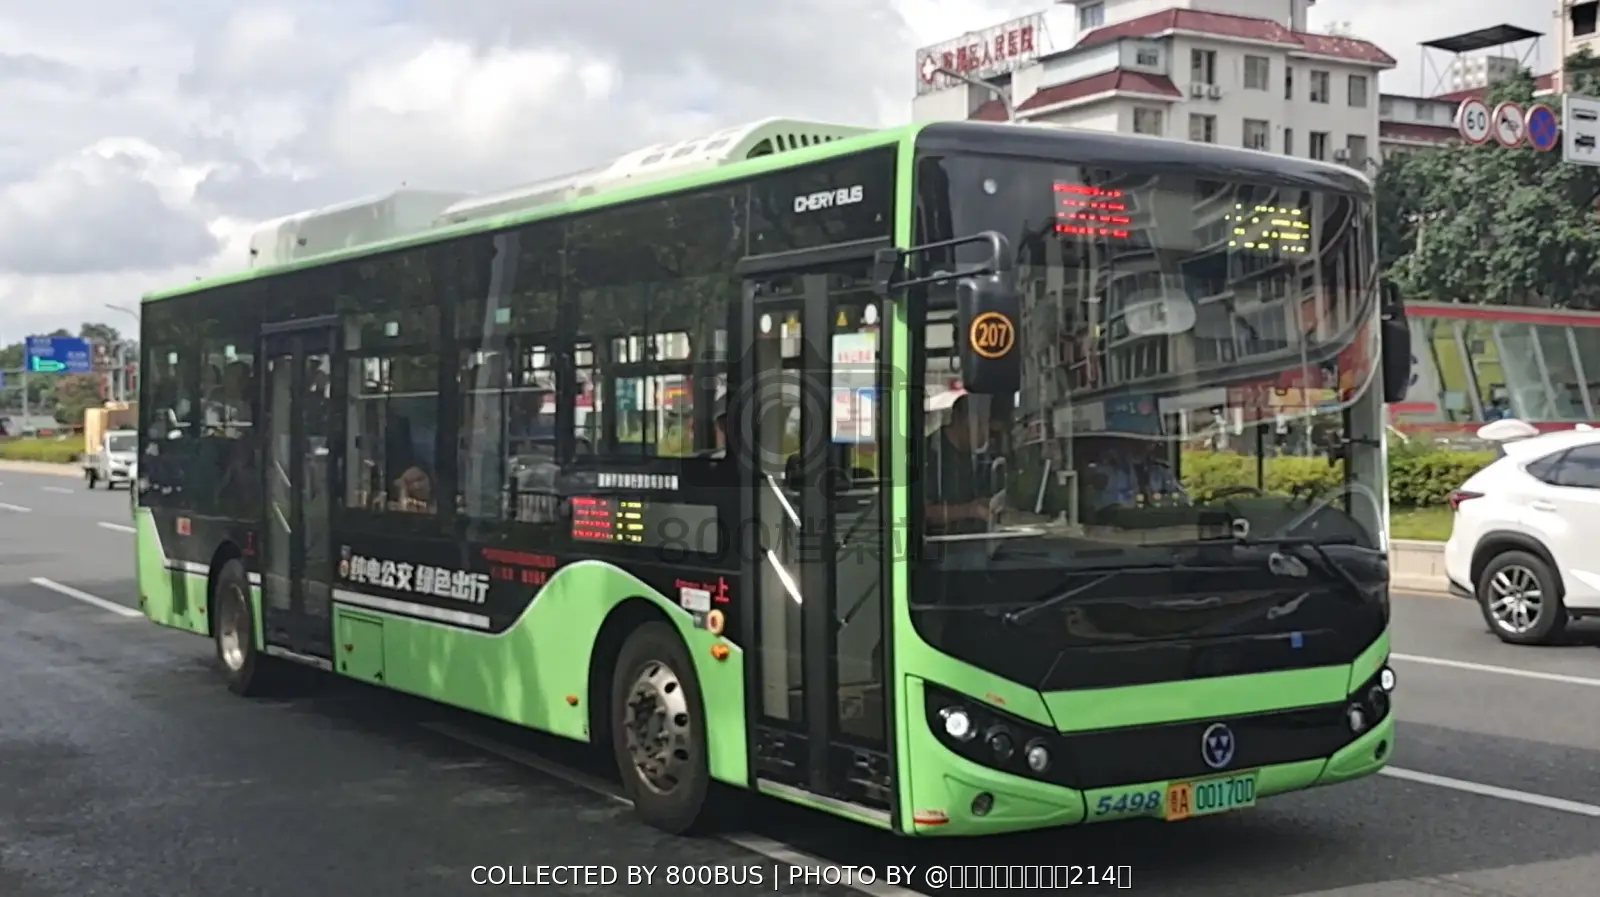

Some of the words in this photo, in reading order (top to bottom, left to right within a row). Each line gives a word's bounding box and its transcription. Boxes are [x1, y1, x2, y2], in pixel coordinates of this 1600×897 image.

[1467, 111, 1486, 131] 60
[794, 191, 836, 213] CHERY
[836, 185, 863, 206] BUS
[977, 322, 1008, 348] 207
[349, 555, 414, 592] 纯电公交
[415, 564, 490, 604] 绿色出行
[1095, 790, 1161, 816] 5498
